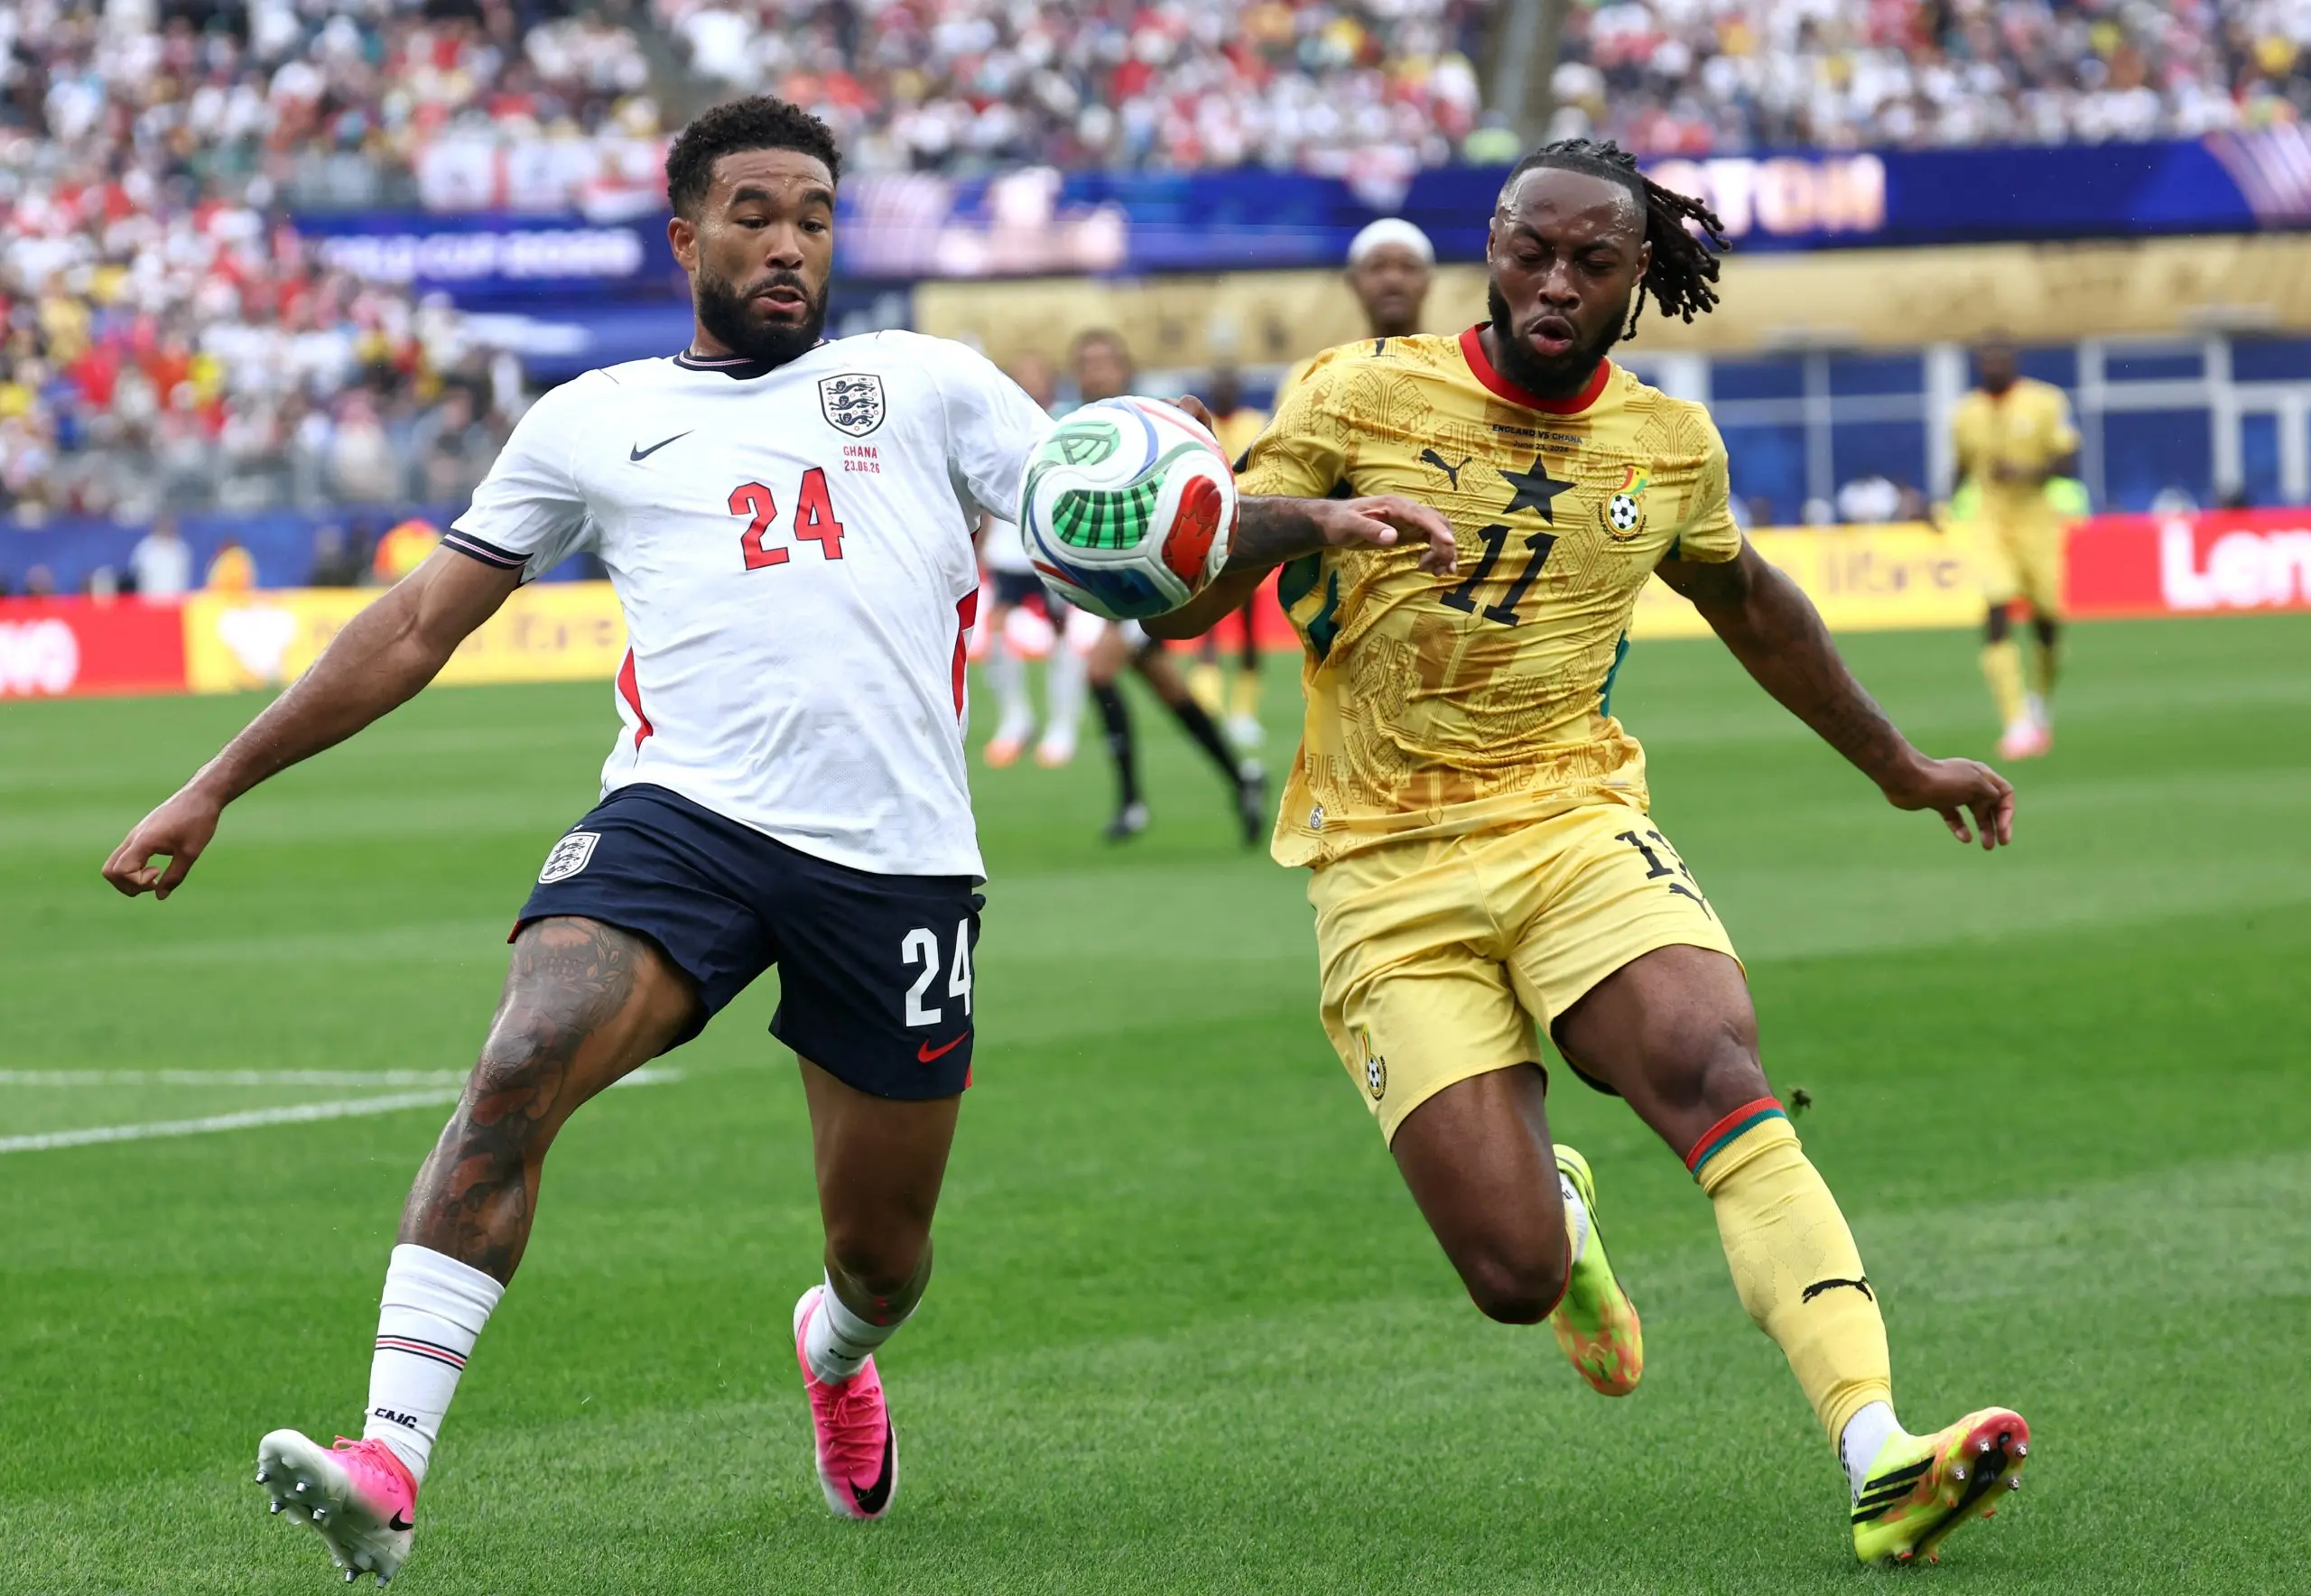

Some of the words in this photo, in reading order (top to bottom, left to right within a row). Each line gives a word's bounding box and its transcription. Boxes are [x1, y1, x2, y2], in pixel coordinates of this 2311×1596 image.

[1492, 424, 1536, 437] ENGLAND
[1537, 431, 1550, 440] VS
[1553, 433, 1582, 444] GHANA
[843, 446, 877, 459] GHANA
[1513, 441, 1534, 449] June
[1550, 444, 1570, 453] 2026
[844, 460, 880, 474] 23.06.26
[728, 467, 845, 571] 24
[1439, 524, 1560, 626] 11
[902, 917, 971, 1026] 24
